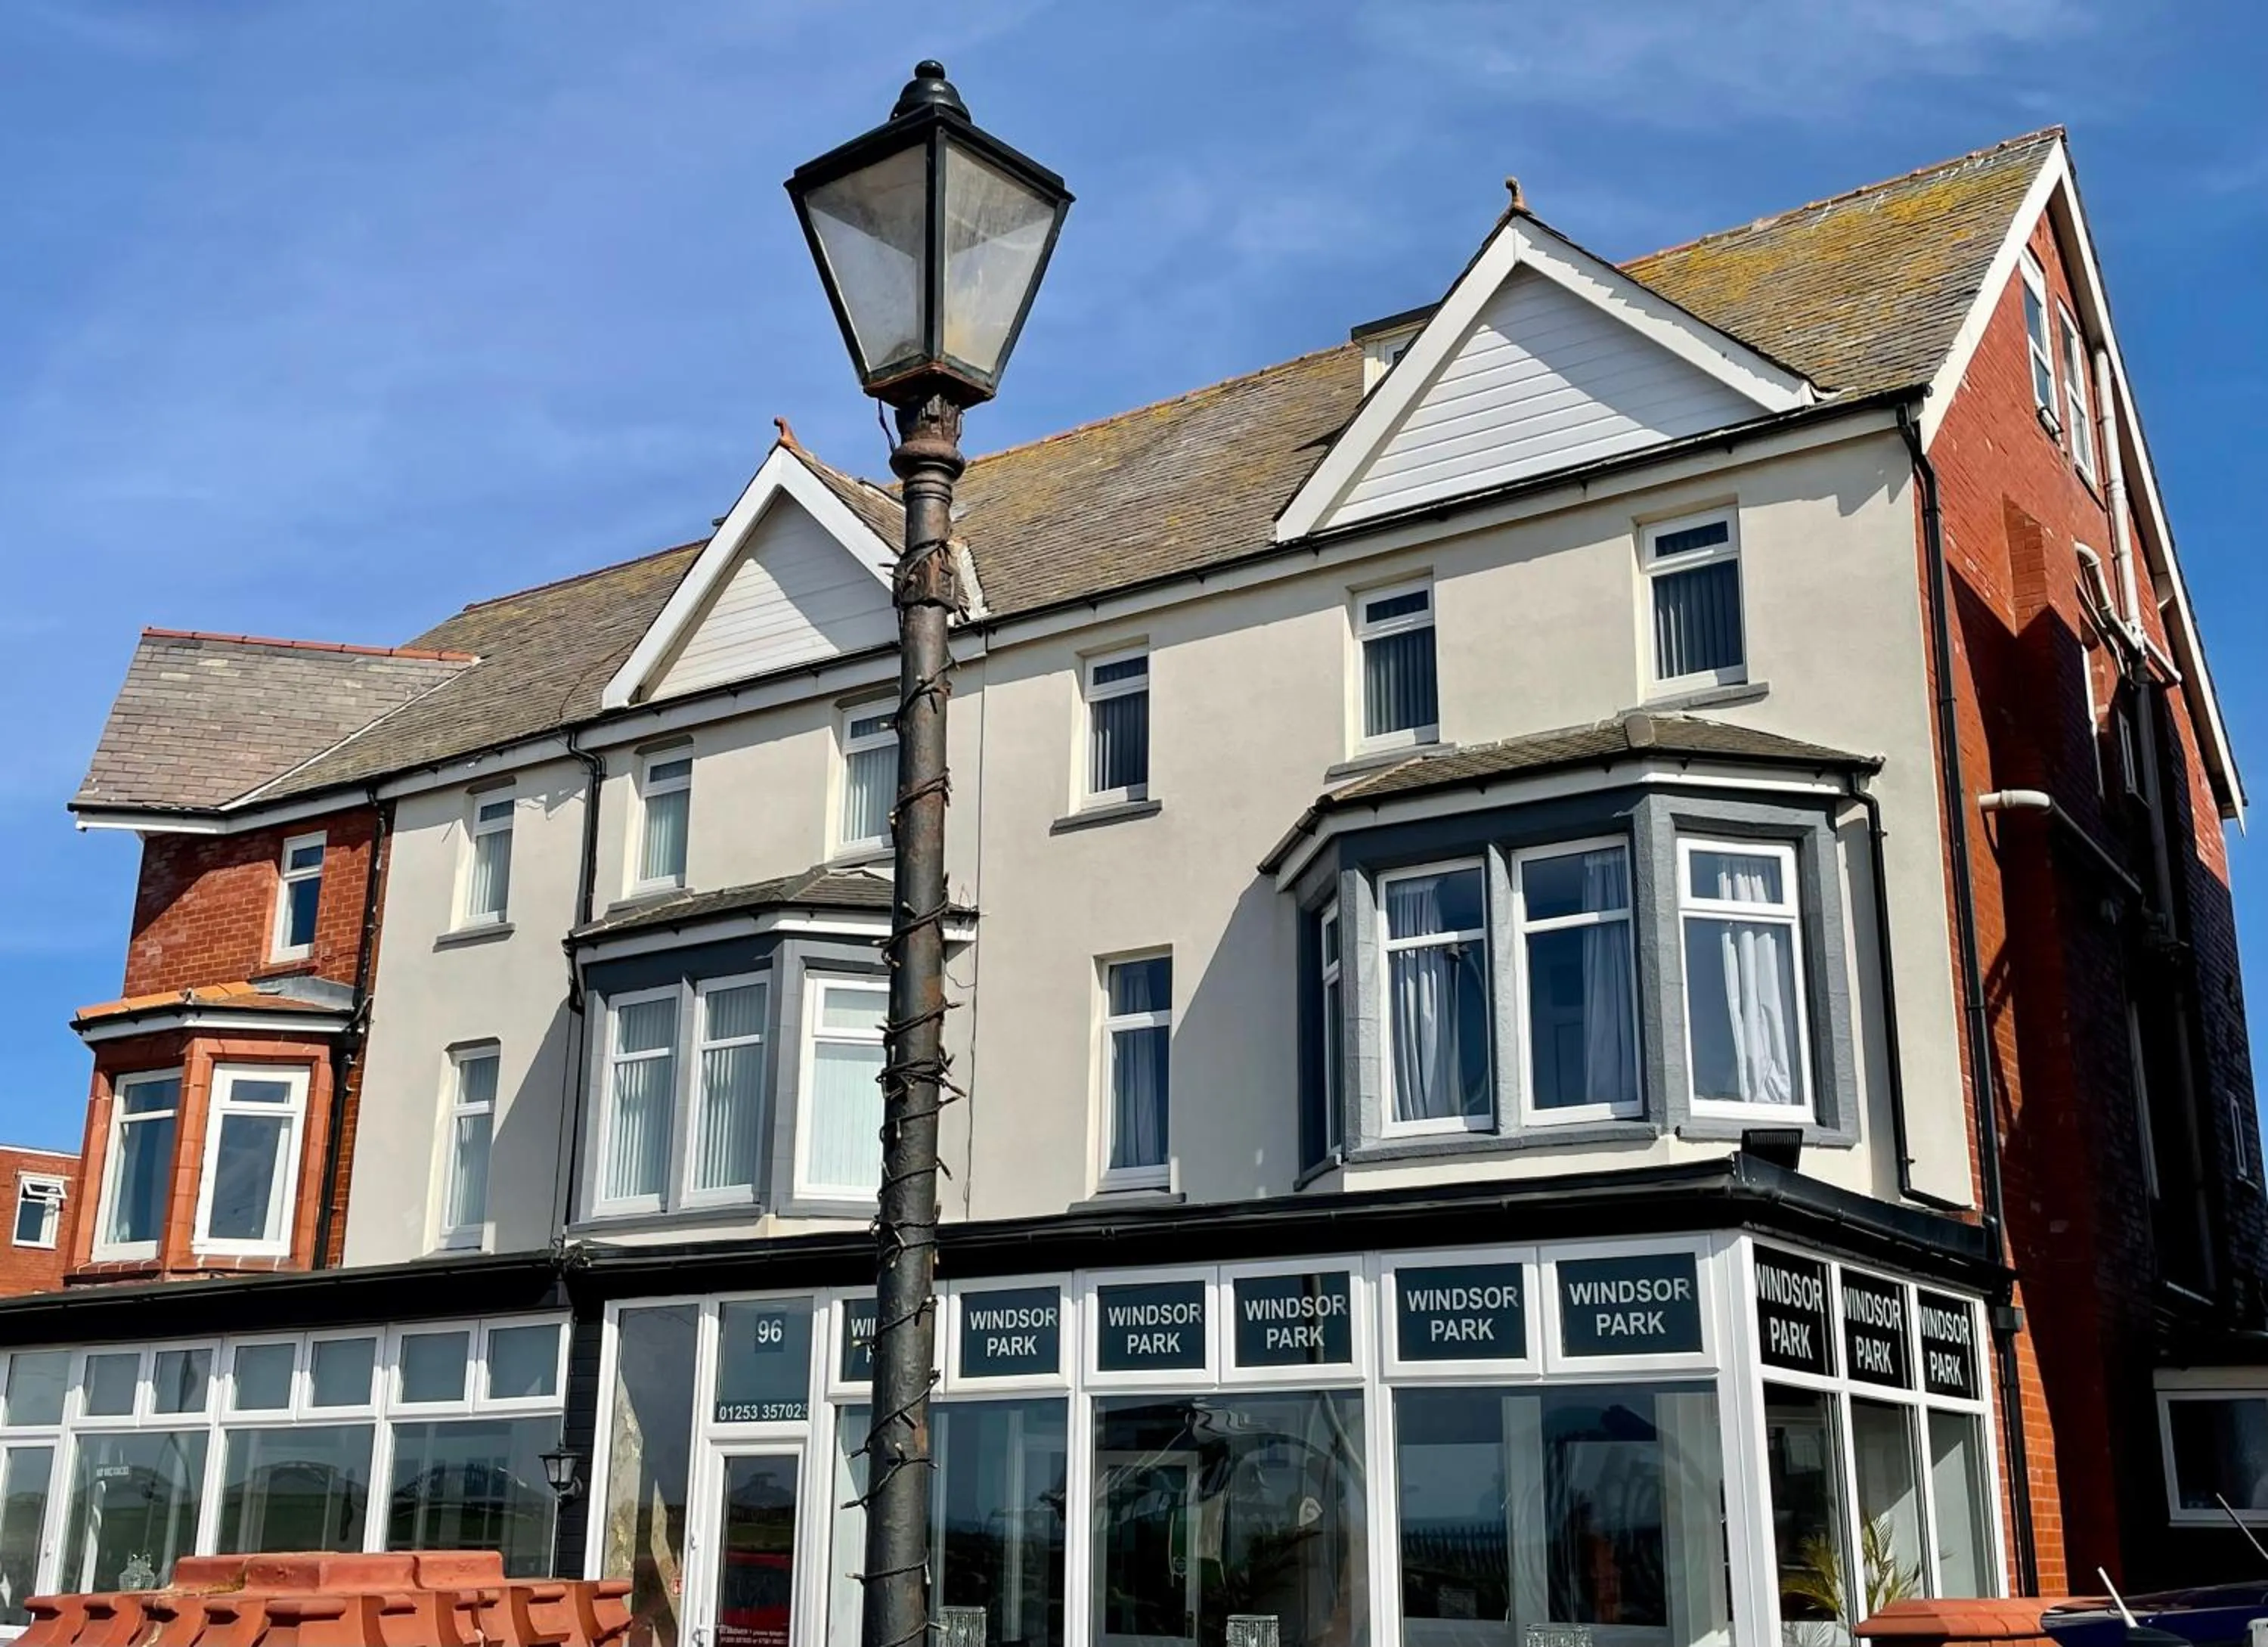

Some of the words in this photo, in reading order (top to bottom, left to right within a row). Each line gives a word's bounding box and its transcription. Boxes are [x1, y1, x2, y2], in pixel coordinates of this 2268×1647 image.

[1407, 1286, 1519, 1312] WINDSOR
[1569, 1277, 1692, 1306] WINDSOR
[1755, 1263, 1824, 1314] WINDSOR
[970, 1307, 1058, 1330] WINDSOR
[1108, 1303, 1203, 1327] WINDSOR
[1244, 1294, 1347, 1321] WINDSOR
[1842, 1286, 1903, 1331] WINDSOR
[758, 1319, 782, 1344] 96
[1430, 1317, 1495, 1341] PARK
[1596, 1310, 1666, 1336] PARK
[987, 1335, 1037, 1357] PARK
[1127, 1332, 1181, 1354] PARK
[1266, 1325, 1325, 1349] PARK
[1769, 1317, 1813, 1360] PARK
[1855, 1335, 1893, 1376] PARK
[1929, 1351, 1963, 1386] PARK
[719, 1404, 758, 1420] 01253
